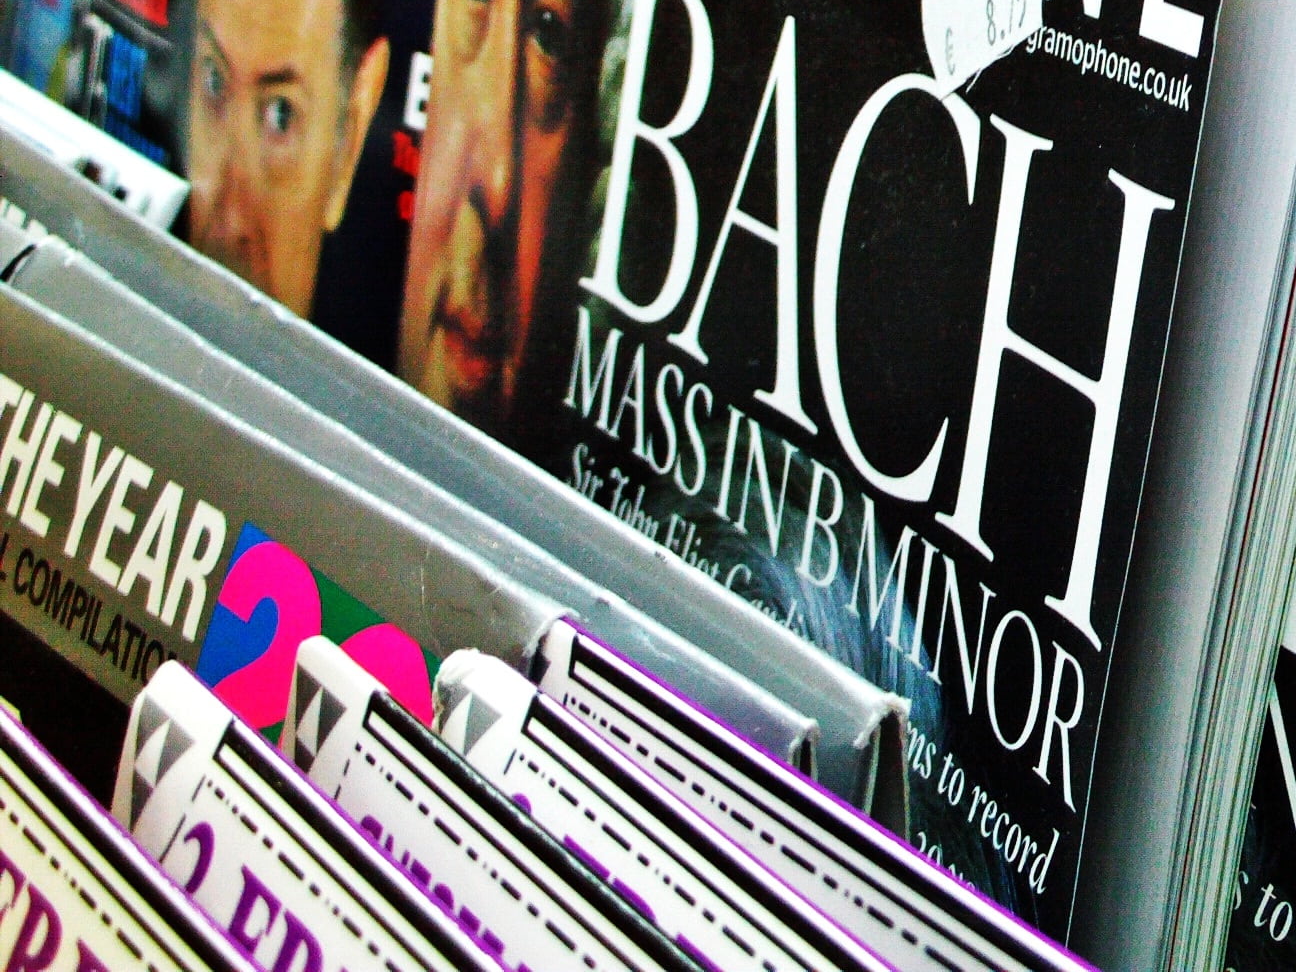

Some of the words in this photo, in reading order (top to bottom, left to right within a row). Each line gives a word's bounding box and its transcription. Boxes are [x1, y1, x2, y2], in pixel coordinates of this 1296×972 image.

[1025, 24, 1194, 113] gramophone.co.uk
[63, 429, 228, 643] YEAR
[564, 304, 712, 498] MASS
[713, 403, 799, 558] IN
[796, 457, 845, 588] B
[845, 492, 1077, 814] MINOR
[12, 547, 178, 688] COMPILATIO
[937, 751, 965, 806] to
[966, 785, 1061, 895] record
[1252, 882, 1293, 943] to
